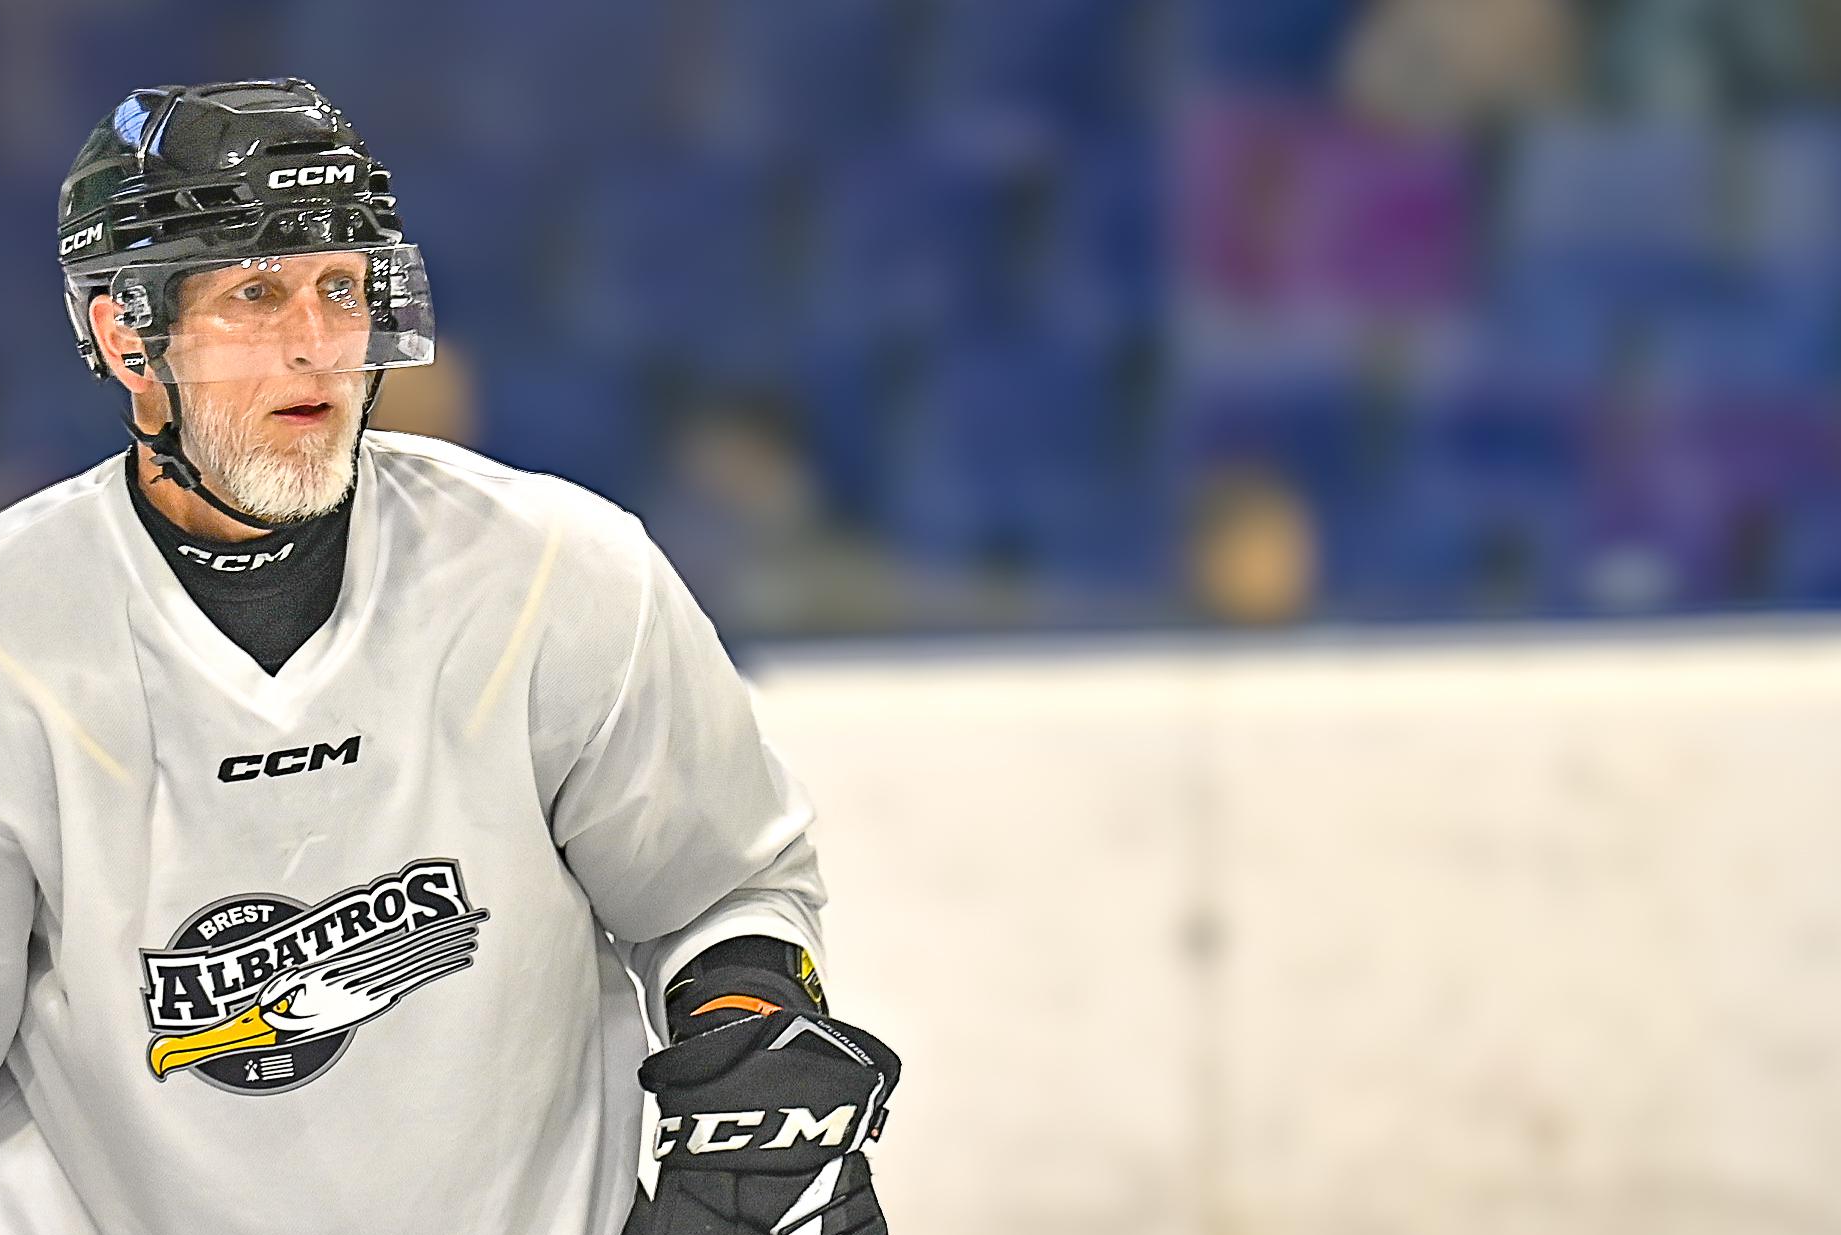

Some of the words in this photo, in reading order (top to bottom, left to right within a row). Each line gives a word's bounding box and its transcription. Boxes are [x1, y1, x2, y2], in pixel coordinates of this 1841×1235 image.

[268, 164, 356, 190] CCM
[60, 222, 104, 256] CCM
[177, 543, 295, 572] CCM
[217, 735, 362, 783] CCM
[197, 904, 275, 941] BREST
[156, 872, 459, 1021] ALBATROS
[653, 1105, 859, 1160] CCM
